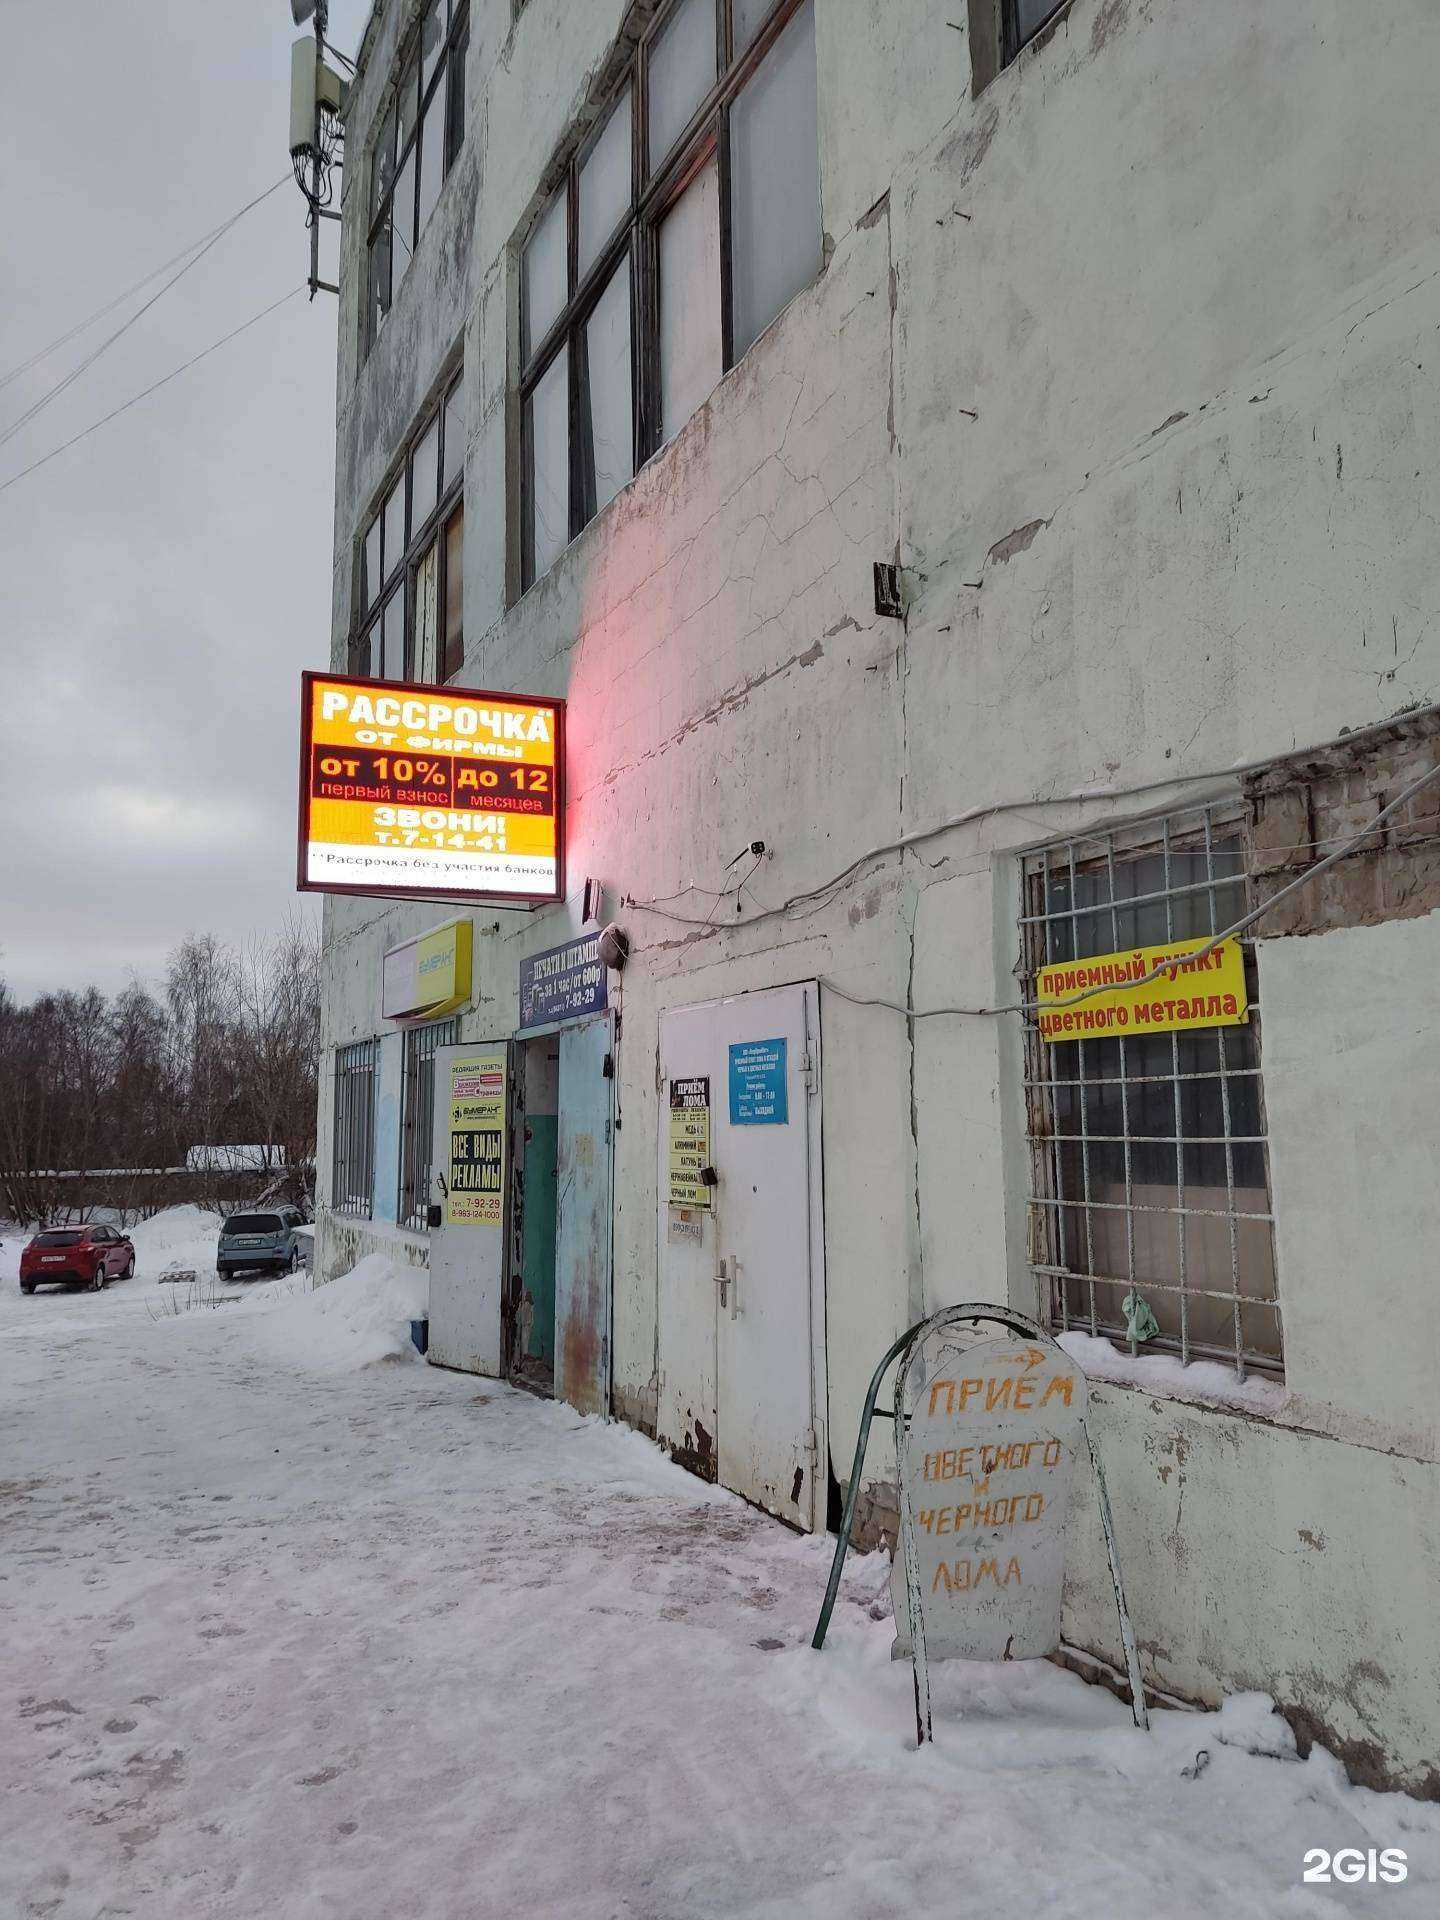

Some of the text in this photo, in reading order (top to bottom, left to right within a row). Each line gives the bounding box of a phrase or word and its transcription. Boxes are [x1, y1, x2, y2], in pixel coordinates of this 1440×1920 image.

[372, 757, 446, 785] 10%
[509, 768, 548, 792] 12
[321, 781, 449, 804] первый взнос
[470, 794, 543, 812] месяцев
[373, 806, 506, 834] ЗВОНИ!
[413, 859, 439, 868] без
[444, 863, 500, 872] участия
[505, 864, 553, 876] банков
[533, 953, 560, 981] ПЕЧАТИ
[1043, 953, 1147, 996] приемный
[565, 987, 595, 1009] 7-92-29
[1040, 993, 1238, 1036] цветного металла
[677, 1078, 705, 1095] ПРИЁМ
[682, 1095, 707, 1107] ЛОМА
[452, 1132, 500, 1162] ВСЕ ВИДЫ
[452, 1164, 500, 1189] РЕКЛАМЫ
[466, 1198, 500, 1209] 7-92-29
[928, 1375, 1074, 1417] ПРИЕМ
[919, 1492, 1044, 1536] ЧЕРНОГО
[932, 1556, 1023, 1594] ЛОМА
